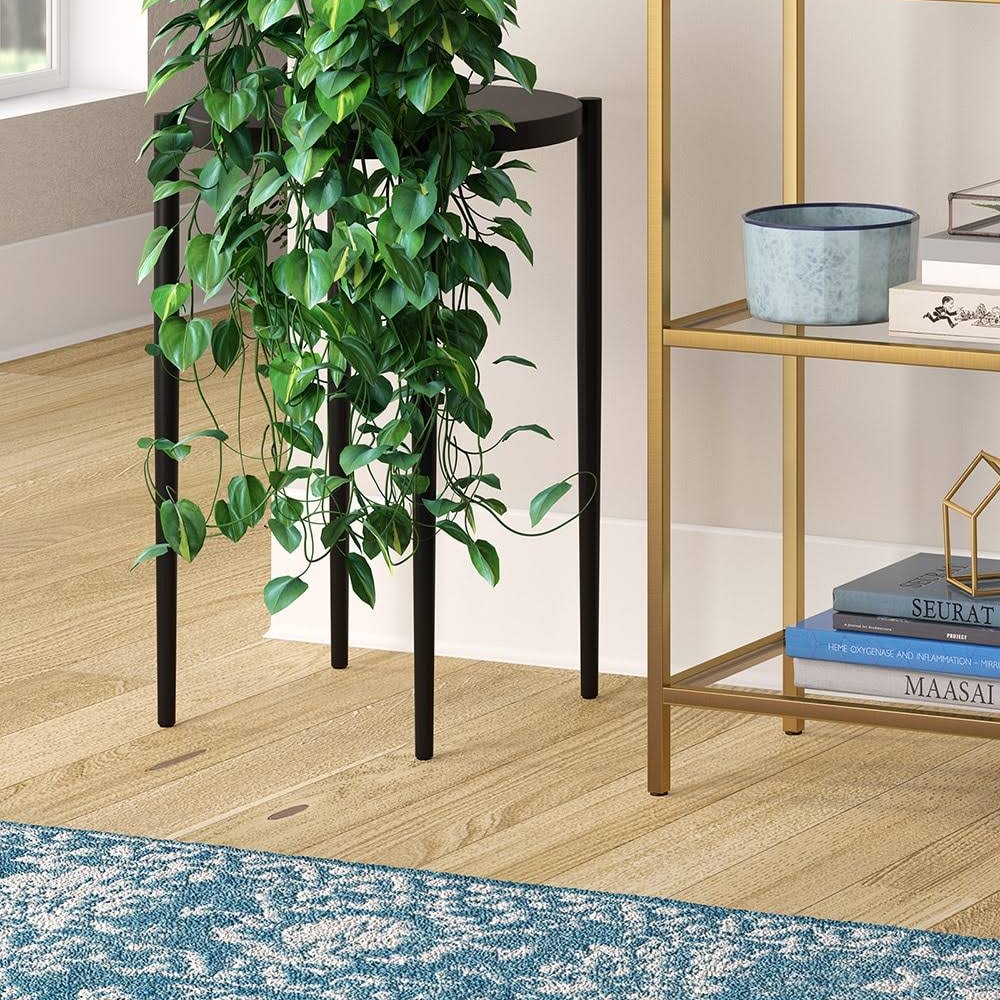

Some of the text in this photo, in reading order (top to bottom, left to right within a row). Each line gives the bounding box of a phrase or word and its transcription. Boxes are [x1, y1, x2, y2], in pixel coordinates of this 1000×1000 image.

[912, 598, 995, 625] SEURAT
[946, 632, 967, 640] PROJECT
[827, 642, 848, 653] HEME
[849, 645, 894, 658] OXYGENASE
[896, 651, 913, 660] AND
[917, 653, 972, 667] INFLAMMATION
[904, 674, 995, 705] MAASAI
